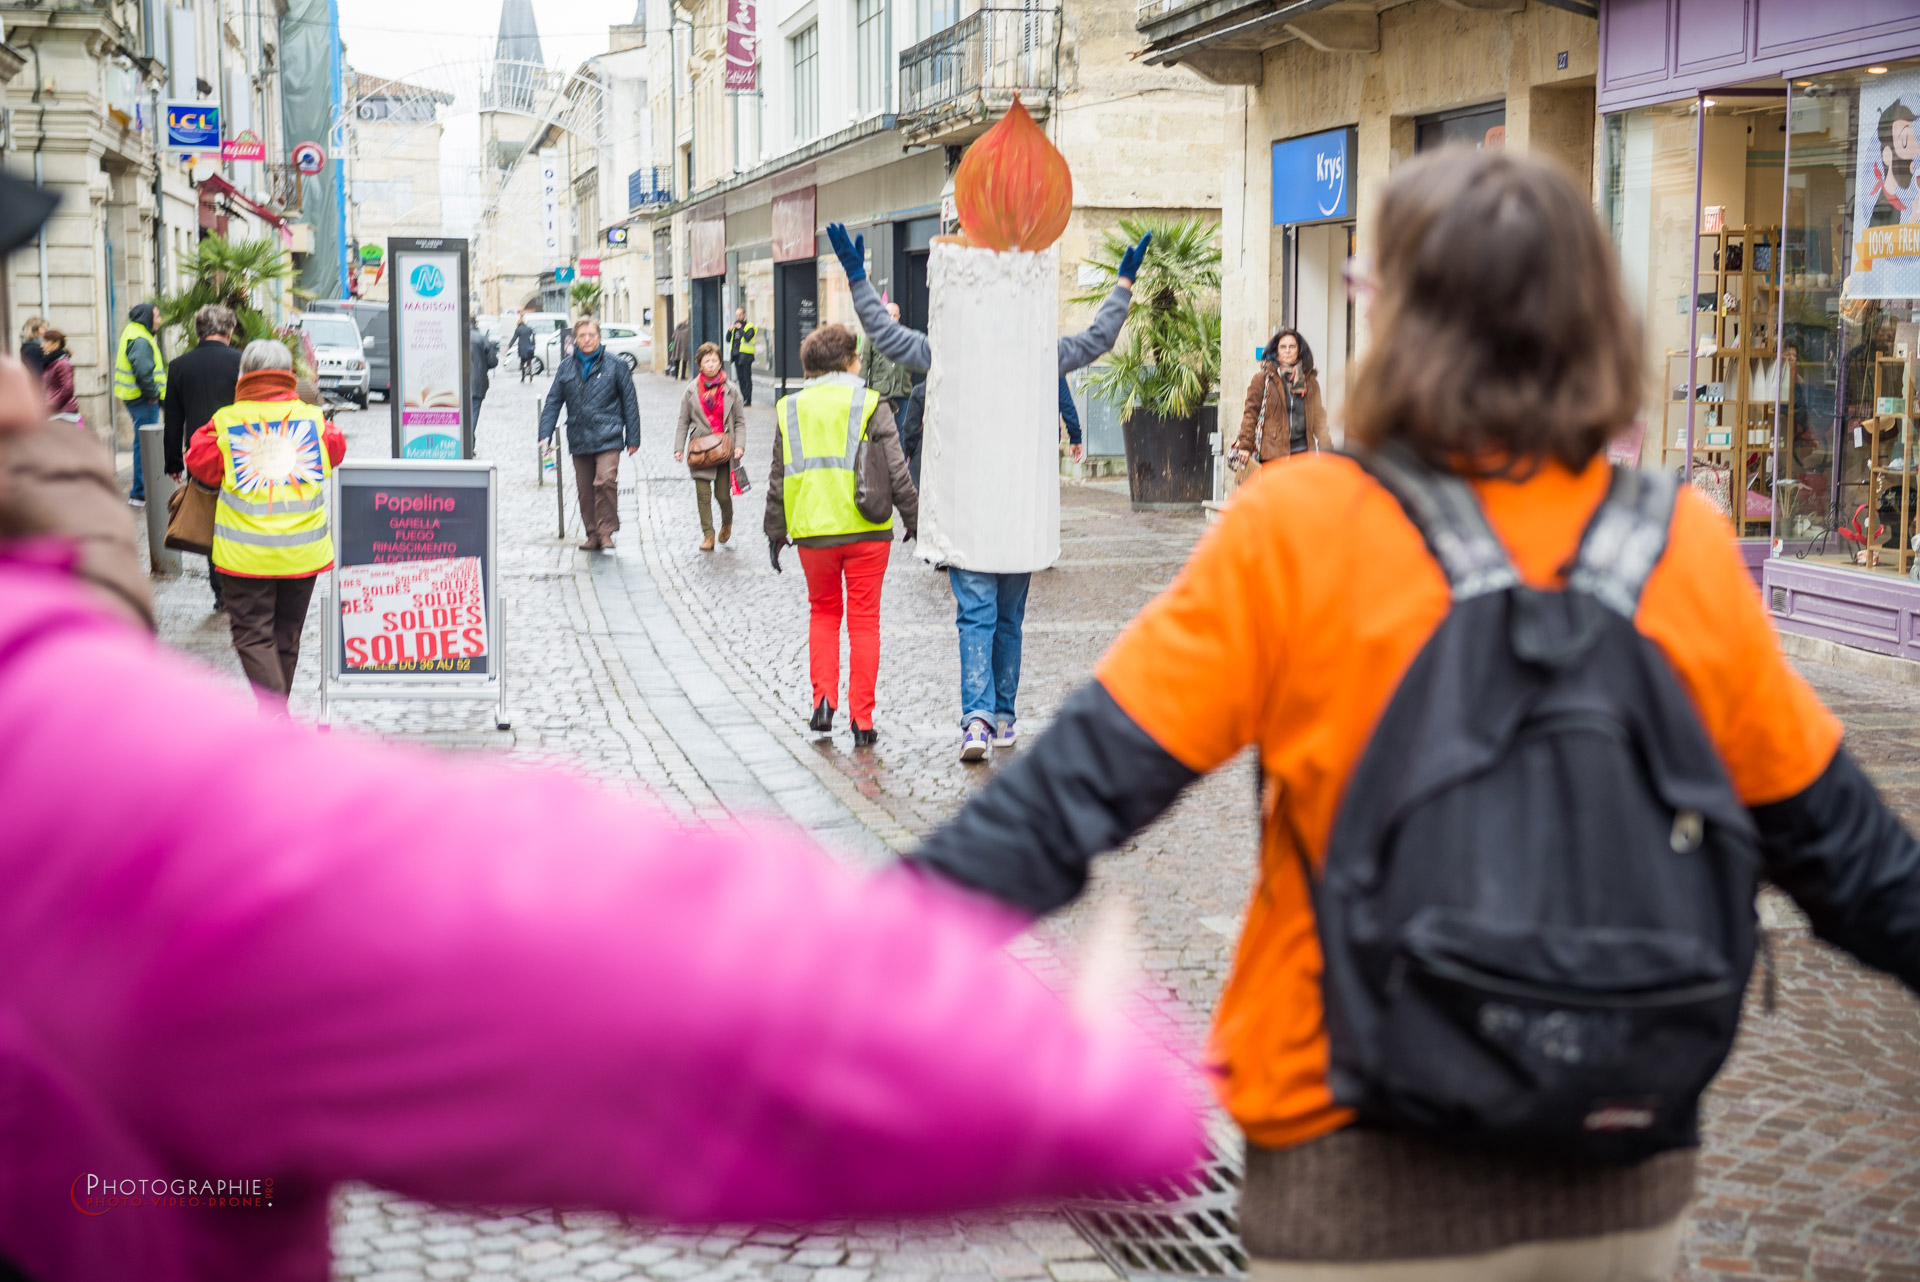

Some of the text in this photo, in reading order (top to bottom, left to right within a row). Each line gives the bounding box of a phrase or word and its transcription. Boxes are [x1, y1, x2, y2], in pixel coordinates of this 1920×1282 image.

[169, 113, 213, 129] LCL
[1317, 152, 1341, 190] Krys
[544, 169, 556, 248] OPTIC
[1868, 230, 1894, 257] 100%
[404, 302, 455, 312] MADISON
[374, 492, 456, 515] Popeline
[389, 517, 440, 529] GARELLA
[395, 530, 435, 541] FUEGO
[372, 542, 457, 553] RINASCIMENTO
[362, 584, 410, 598] SOLDES
[412, 590, 481, 609] SOLDES
[382, 605, 482, 632] SOLDES
[345, 627, 485, 667] SOLDES
[436, 658, 454, 671] AU
